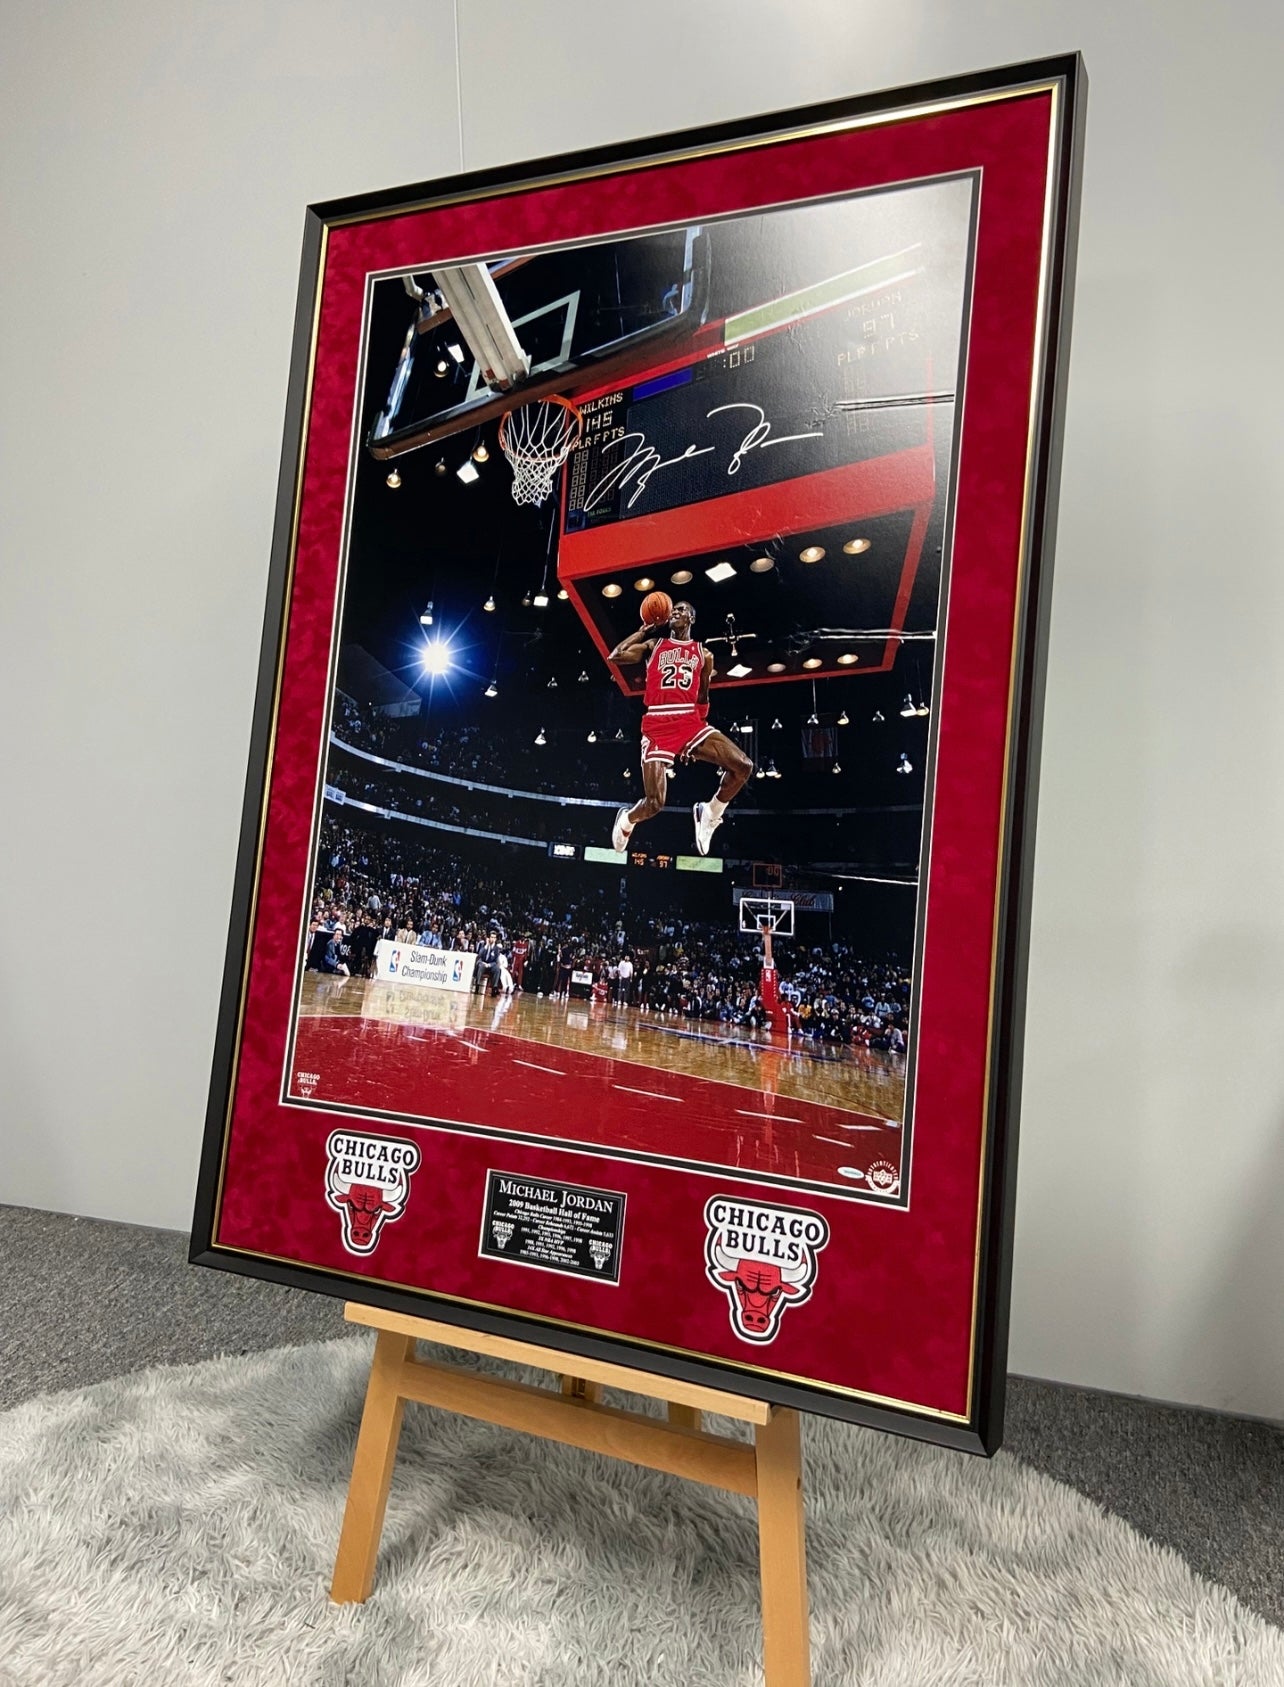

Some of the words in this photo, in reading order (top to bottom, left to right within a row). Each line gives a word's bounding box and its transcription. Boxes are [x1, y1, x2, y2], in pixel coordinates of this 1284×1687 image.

[658, 646, 699, 670] BULLS
[661, 664, 693, 690] 23
[401, 965, 448, 984] Championship
[333, 1137, 415, 1167] CHICAGO
[341, 1159, 399, 1184] BULLS
[499, 1180, 558, 1203] MICHAEL
[560, 1190, 614, 1214] JORDAN
[525, 1201, 558, 1215] Basketball
[559, 1208, 572, 1218] Hall
[573, 1212, 581, 1220] of
[581, 1212, 600, 1224] Fame
[713, 1204, 821, 1242] CHICAGO
[725, 1229, 800, 1262] BULLS
